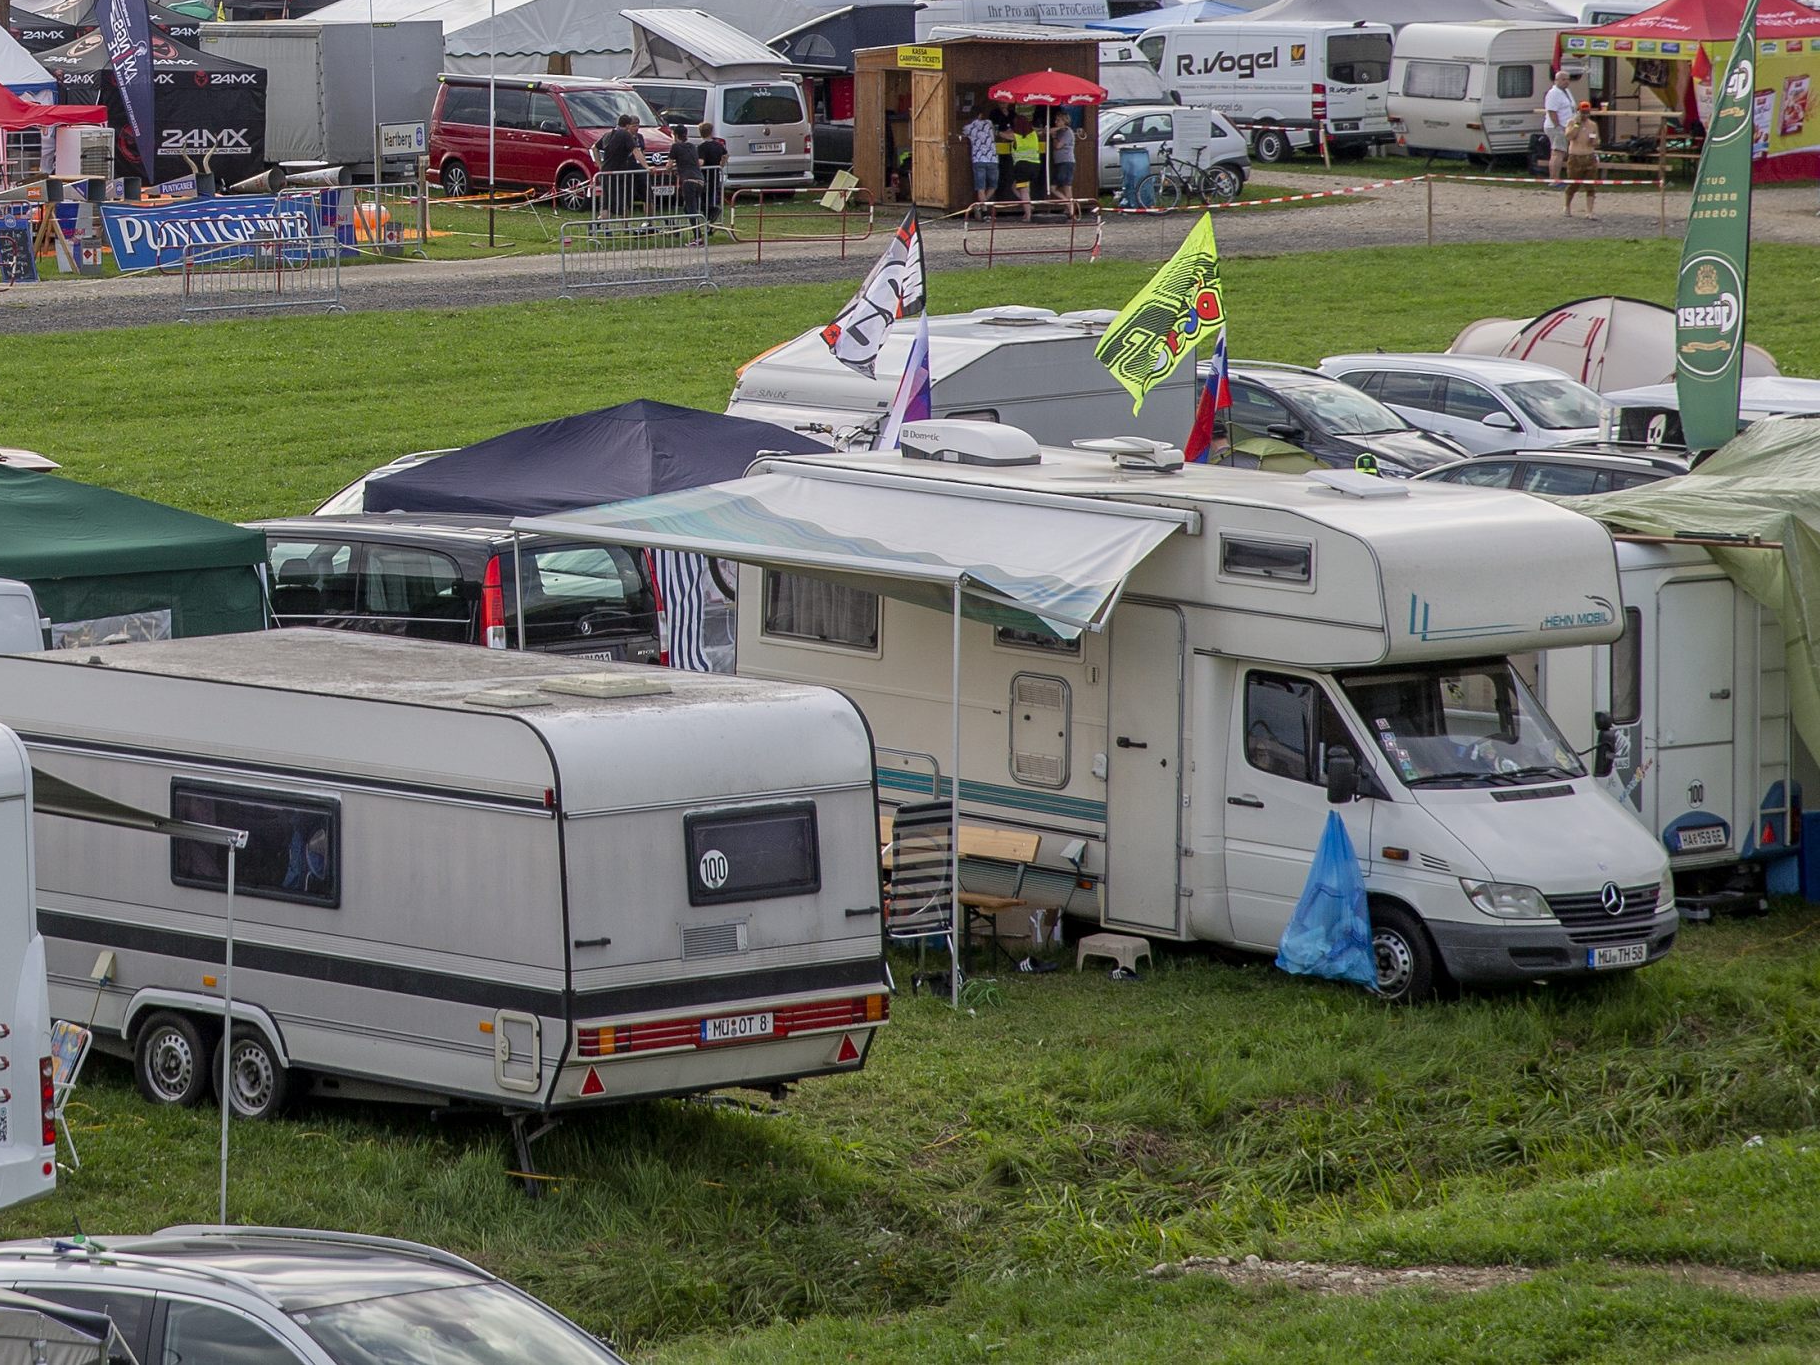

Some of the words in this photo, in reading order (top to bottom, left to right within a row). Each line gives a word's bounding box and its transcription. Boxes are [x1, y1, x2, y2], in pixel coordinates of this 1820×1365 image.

[988, 4, 1002, 19] Ihr
[1004, 3, 1022, 18] Pro
[1024, 7, 1036, 18] an
[1039, 2, 1058, 17] Van
[22, 31, 65, 40] 24MX
[211, 74, 257, 84] 24MX
[162, 129, 250, 148] 24MX
[160, 180, 194, 193] PUNTIGAMER
[1546, 616, 1574, 626] HEHN
[1577, 613, 1610, 624] MOBIL
[1690, 784, 1704, 804] 100
[703, 857, 727, 883] 100
[713, 1019, 730, 1037] MÜ
[739, 1016, 755, 1034] OT
[760, 1015, 767, 1032] 8
